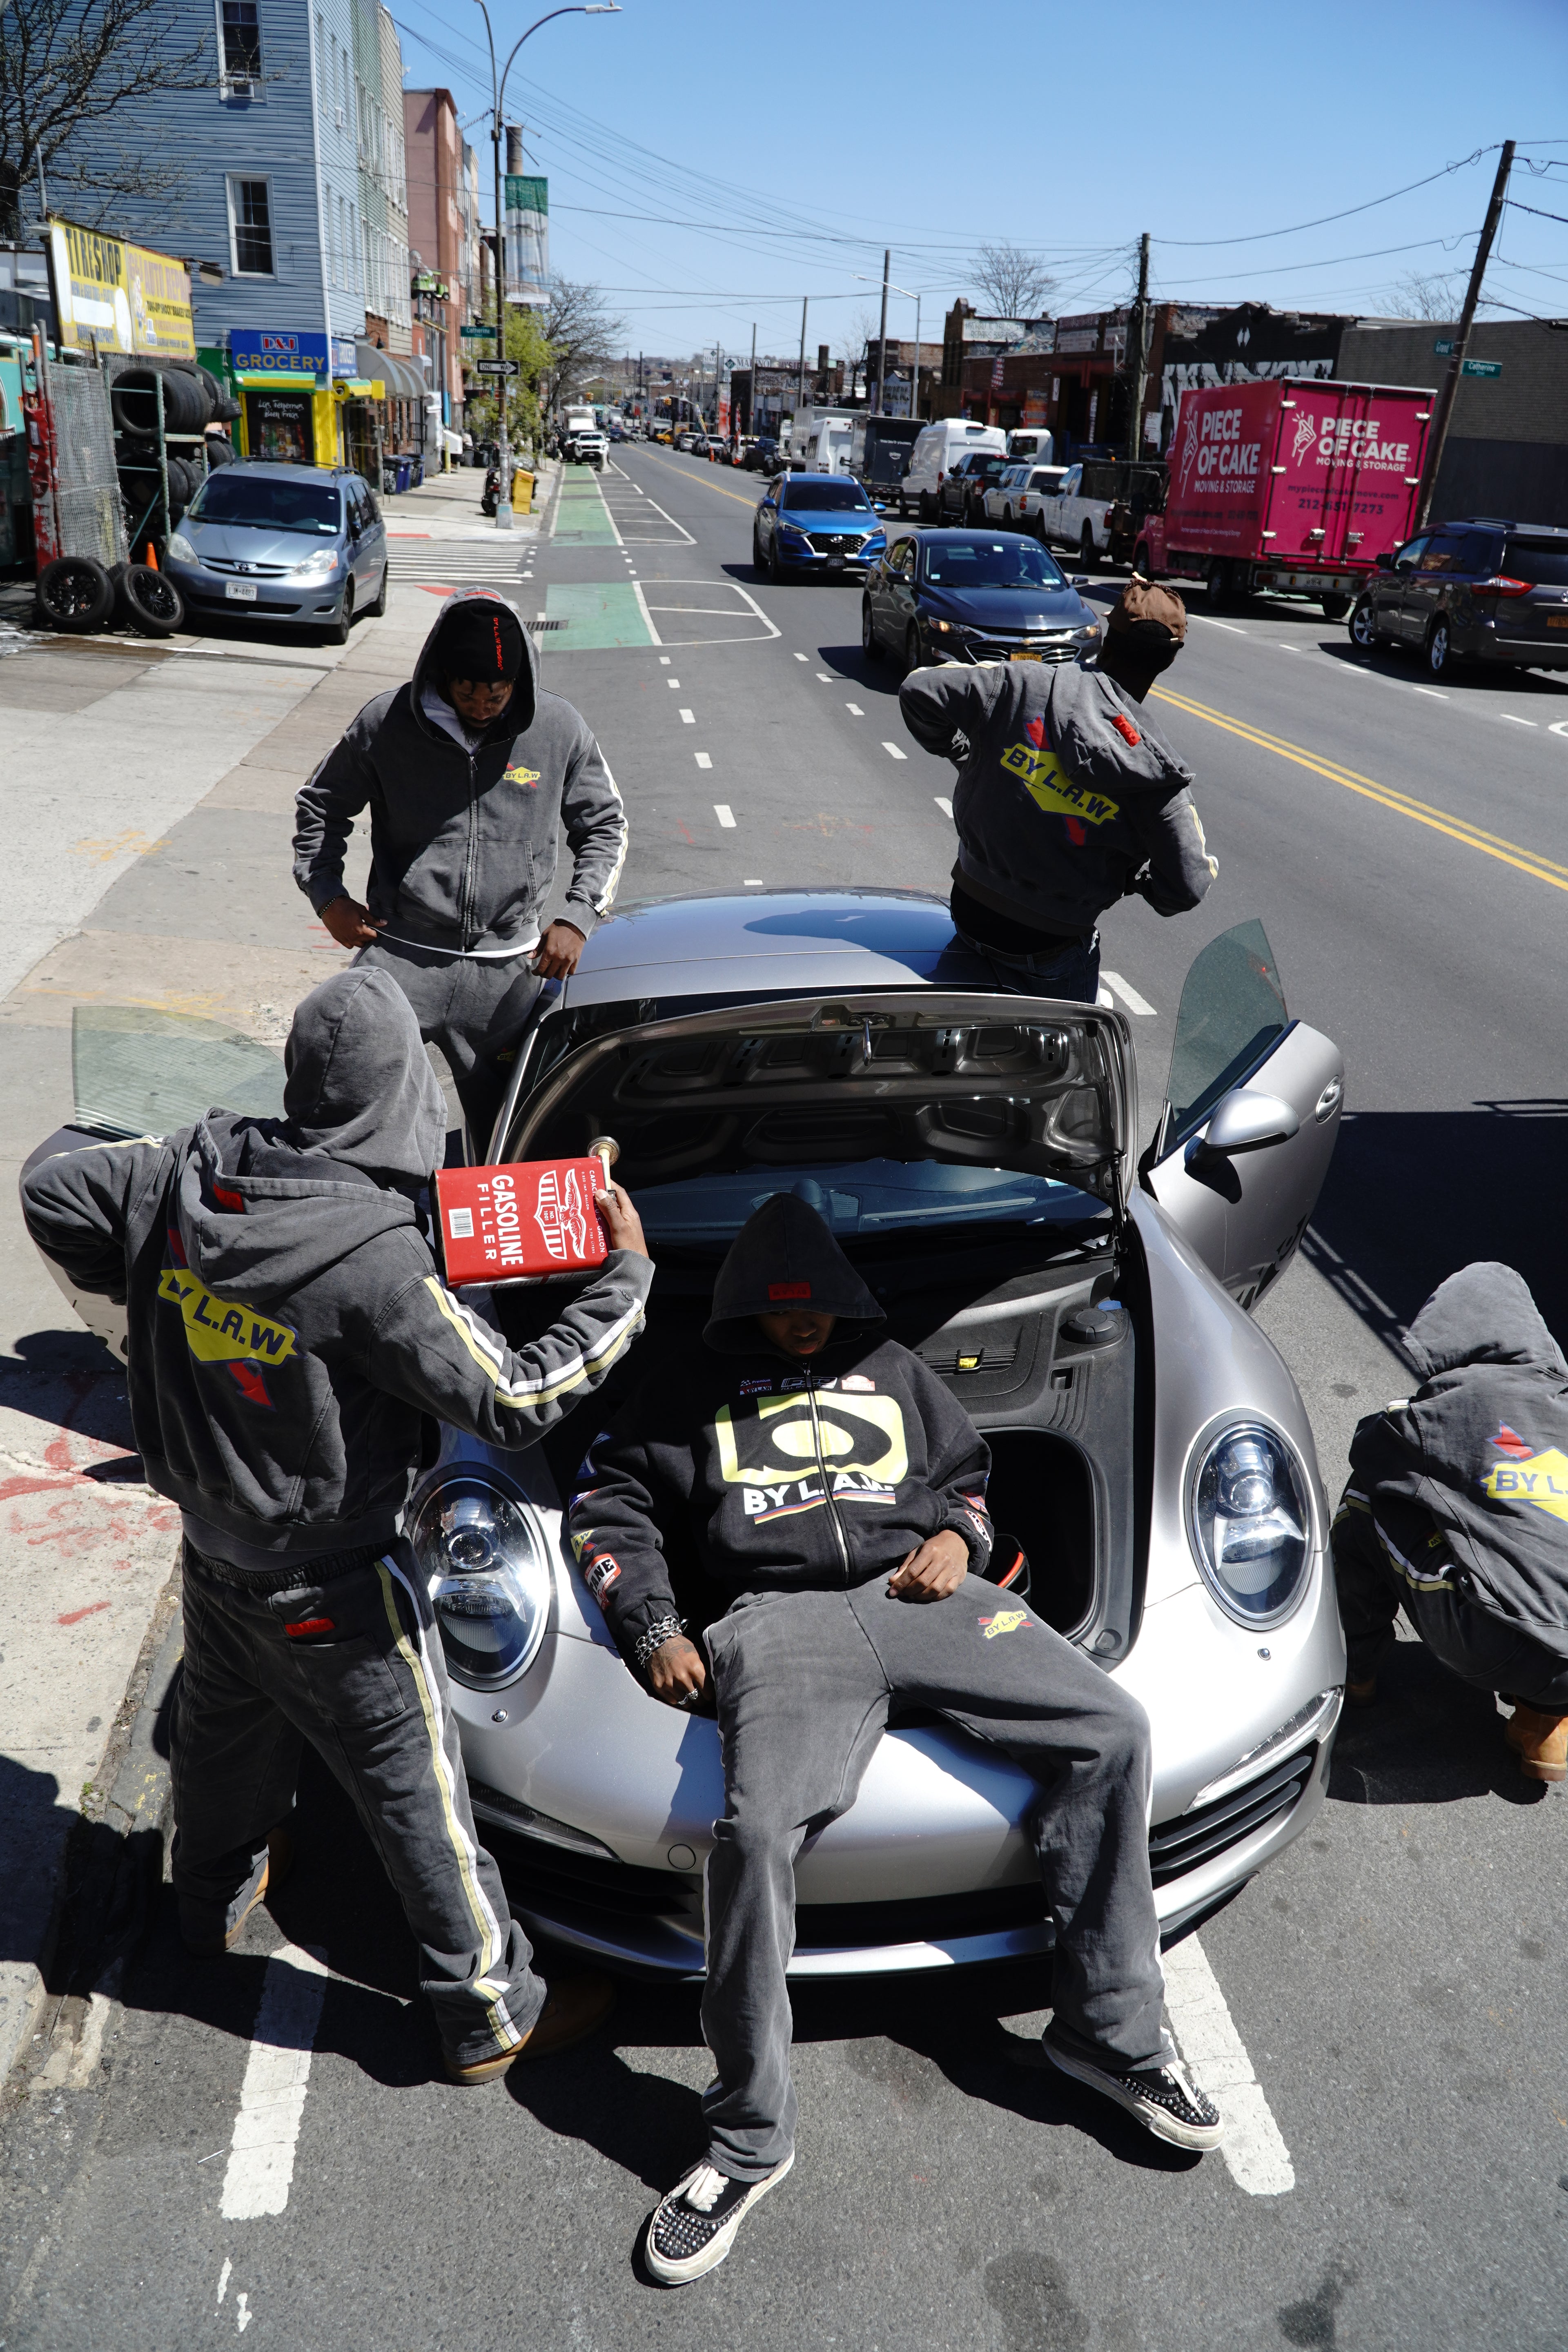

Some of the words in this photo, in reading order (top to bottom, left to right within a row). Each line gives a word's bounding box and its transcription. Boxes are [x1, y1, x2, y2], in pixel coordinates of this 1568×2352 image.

[263, 337, 295, 350] D&J
[236, 354, 325, 370] GROCERY
[1468, 362, 1495, 372] Catherine
[1201, 409, 1243, 441] PIECE
[1321, 416, 1380, 439] PIECE
[1197, 445, 1219, 475] OF
[1219, 443, 1261, 475] CAKE
[1319, 437, 1349, 456] OF
[1351, 440, 1410, 462] CAKE
[1316, 457, 1354, 468] MOVING
[1363, 461, 1406, 472] STORAGE
[1194, 480, 1219, 493] MOVING
[1225, 480, 1256, 494] STORAGE
[1006, 748, 1044, 774] BY
[1042, 770, 1112, 818] L.A.W
[477, 1183, 497, 1260] FILLER
[492, 1175, 523, 1266] GASOLINE
[597, 1225, 606, 1253] GALLON
[194, 1295, 286, 1356] L.A.W
[1496, 1470, 1539, 1492] BY
[743, 1484, 791, 1515] BY
[987, 1624, 1000, 1635] BY
[1001, 1613, 1024, 1626] L.A.W
